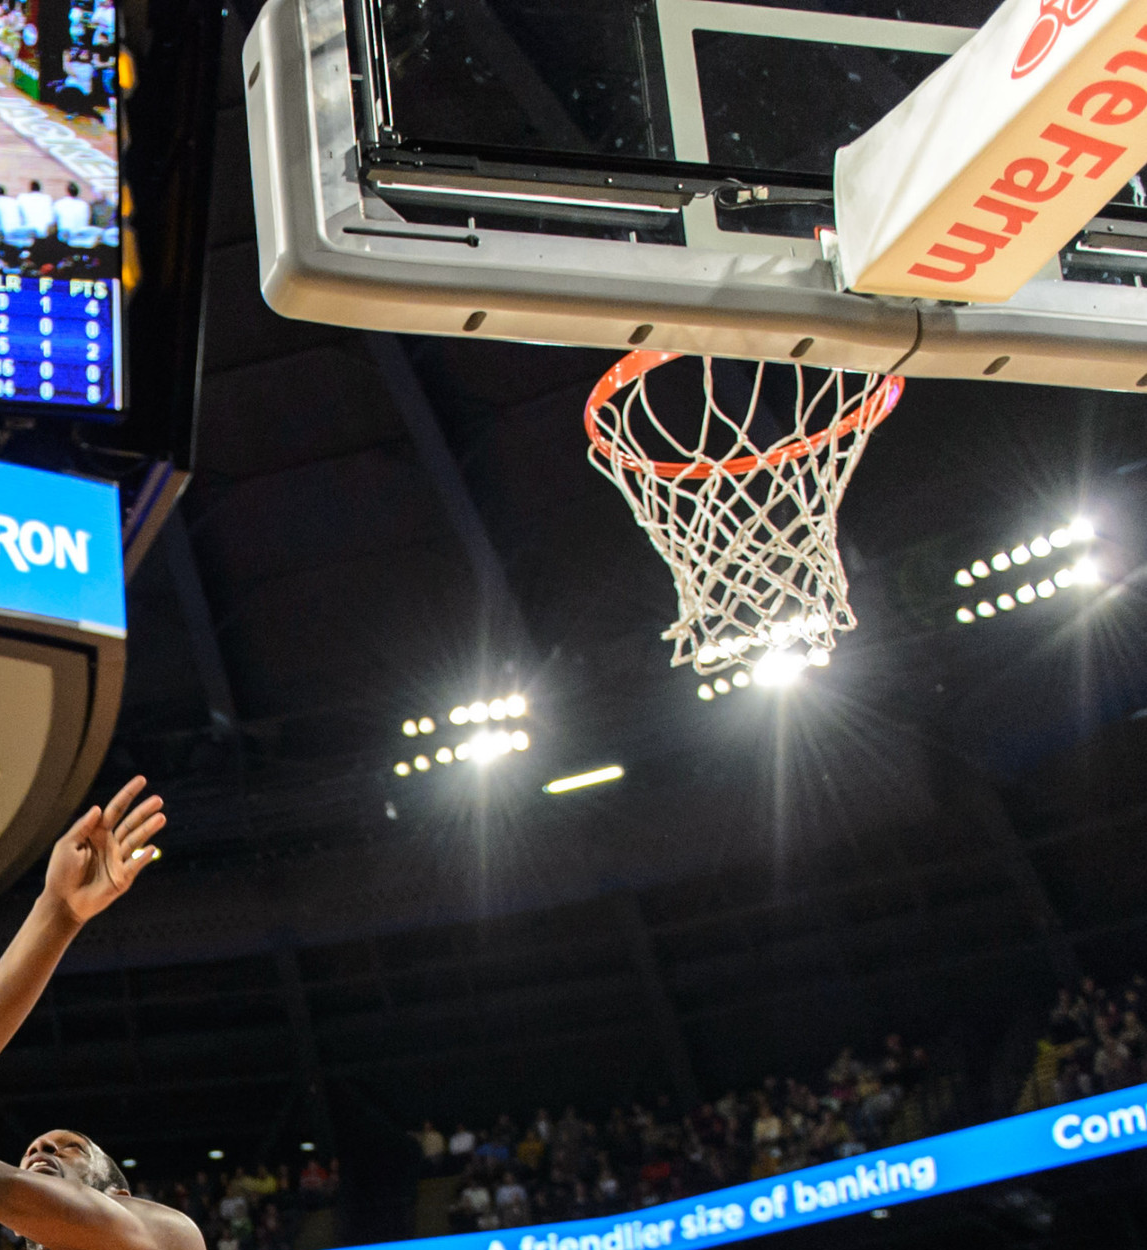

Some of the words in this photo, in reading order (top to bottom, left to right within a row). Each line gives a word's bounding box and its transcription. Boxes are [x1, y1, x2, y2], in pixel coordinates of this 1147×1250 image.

[39, 277, 53, 295] F
[70, 279, 108, 299] PTS
[40, 296, 51, 314] 1
[85, 299, 100, 318] 4
[40, 317, 53, 336] 0
[85, 320, 99, 339] 0
[40, 340, 51, 358] 1
[86, 343, 99, 362] 2
[39, 361, 53, 380] 0
[39, 381, 53, 400] 0
[680, 1201, 745, 1240] size
[750, 1184, 788, 1223] of
[793, 1156, 937, 1213] banking
